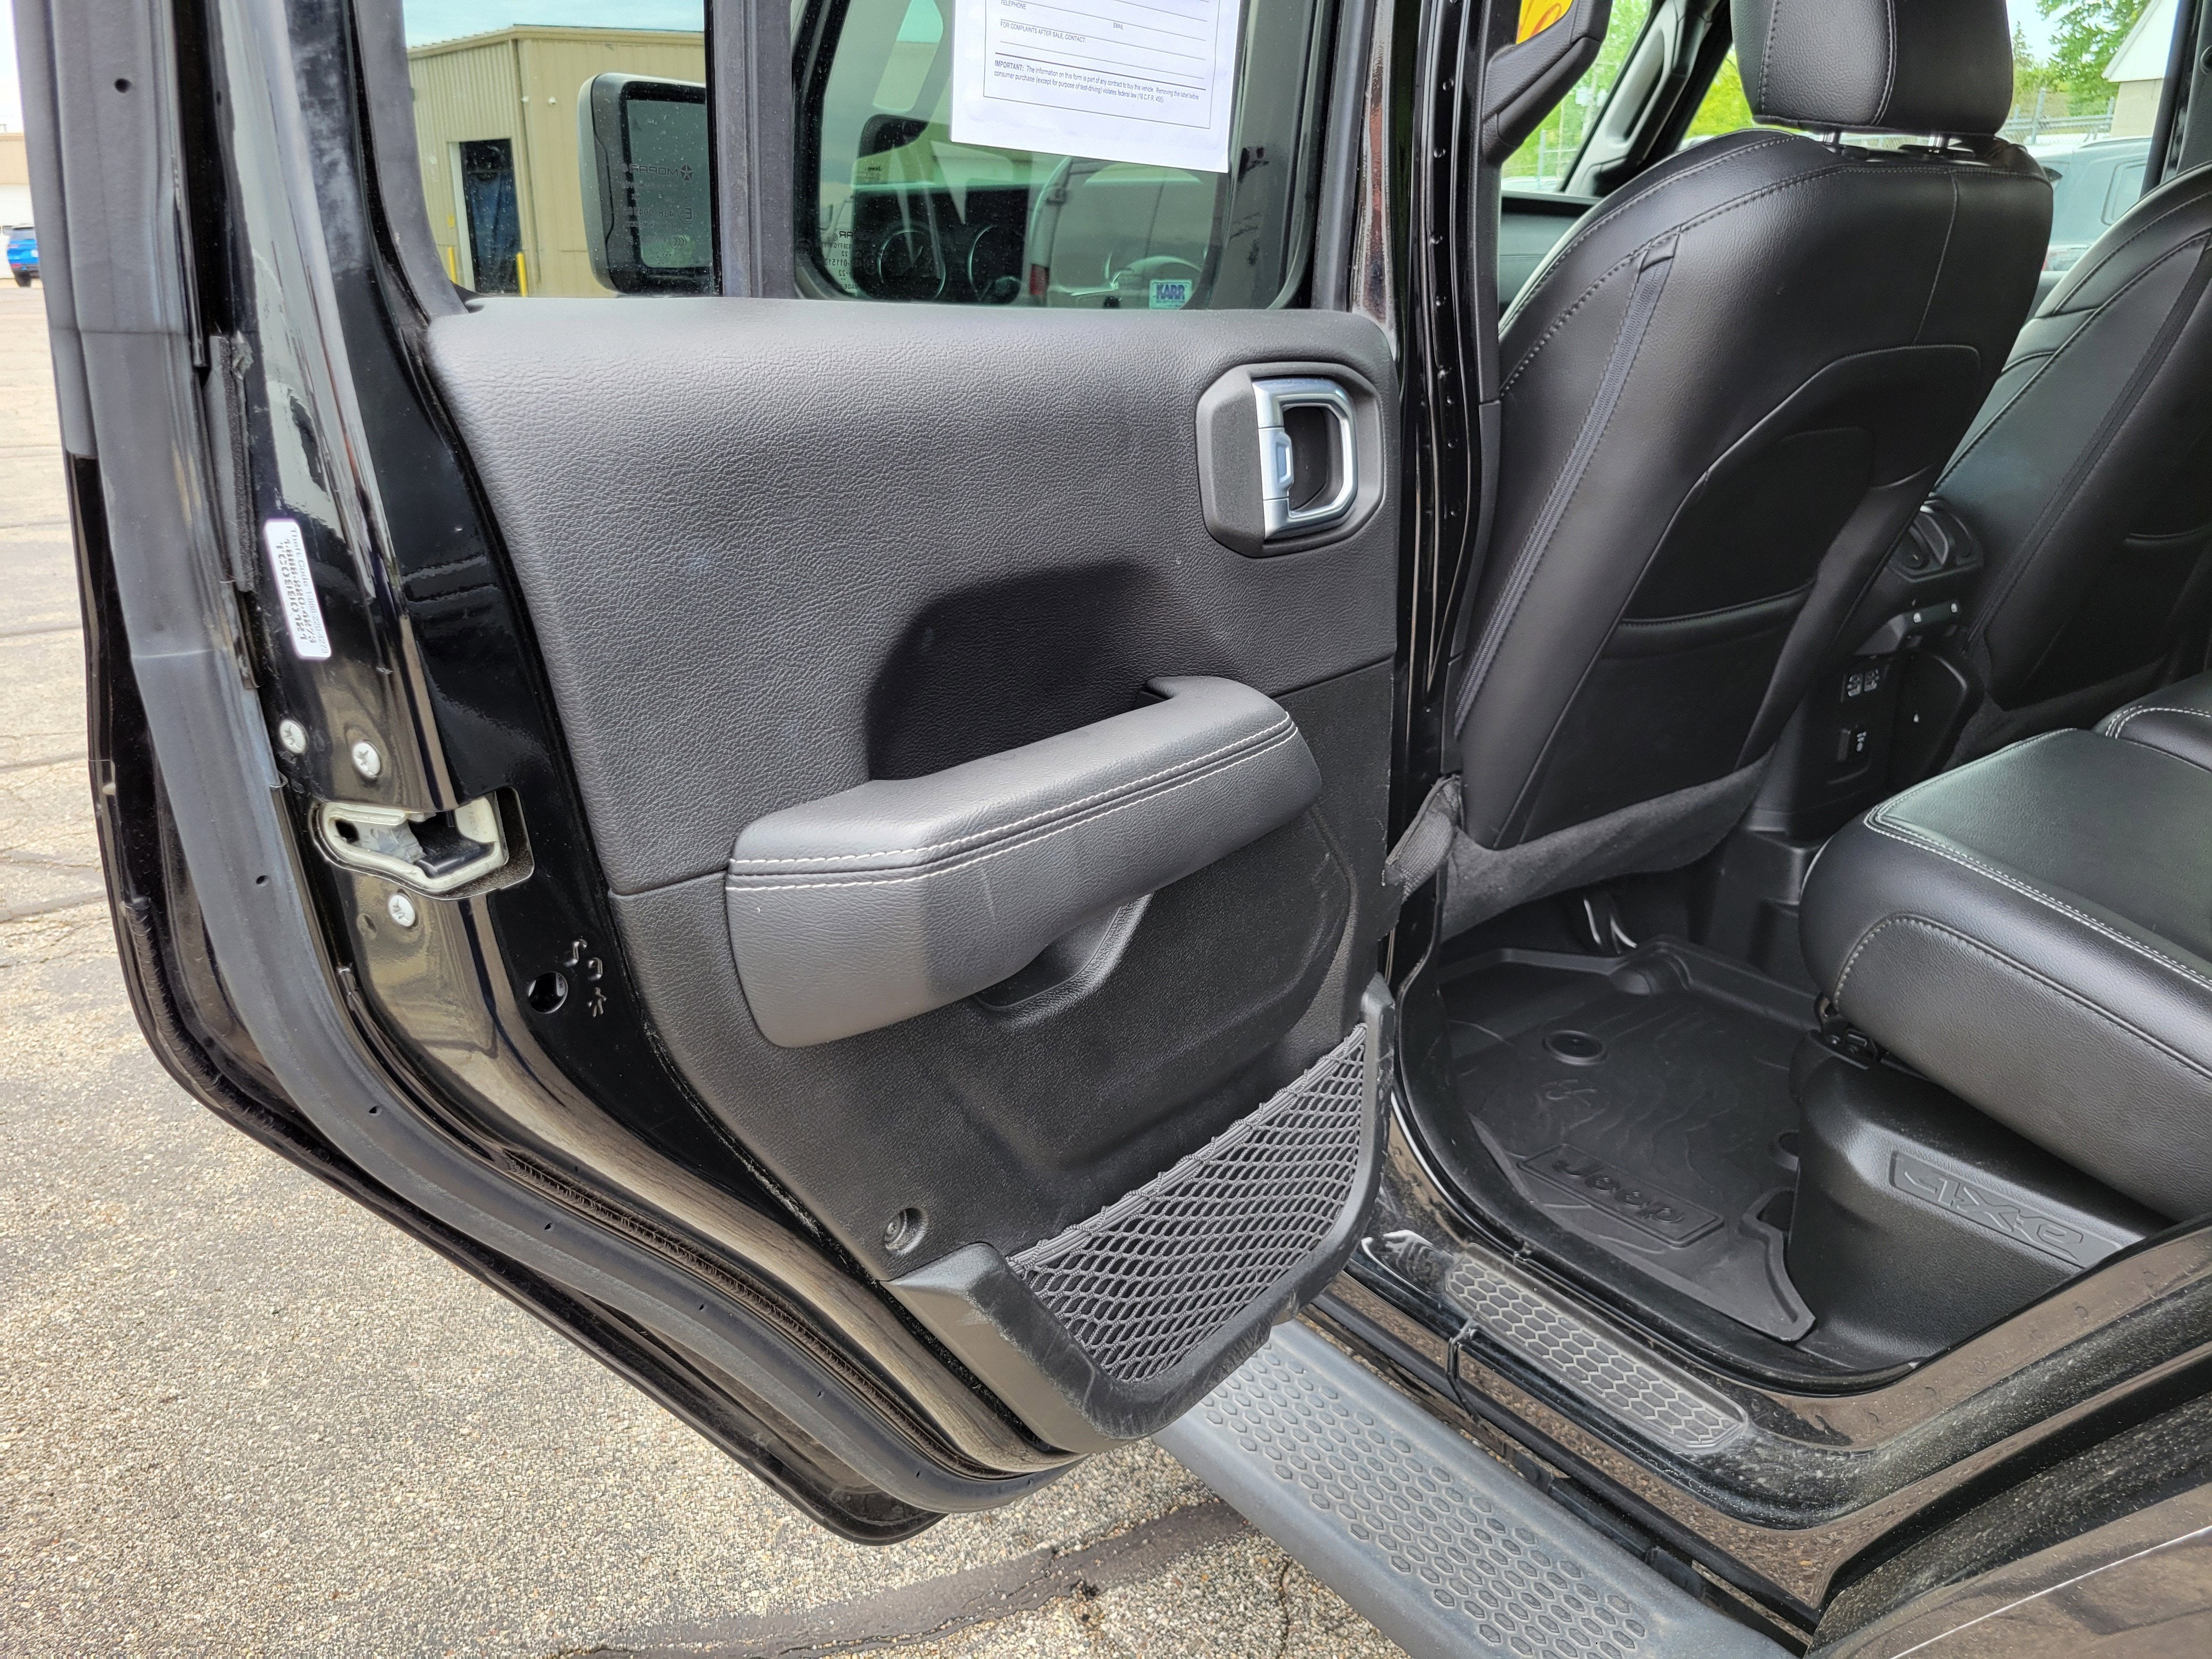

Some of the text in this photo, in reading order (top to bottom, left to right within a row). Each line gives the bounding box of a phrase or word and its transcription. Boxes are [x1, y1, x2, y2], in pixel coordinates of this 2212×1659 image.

[1001, 0, 1026, 10] TELEPHONE
[1011, 23, 1037, 34] COMPLAINTS
[1038, 29, 1052, 37] AFTER
[994, 70, 1015, 79] consumer
[1015, 75, 1035, 83] purchase
[1036, 76, 1052, 86] (except
[1058, 81, 1075, 89] purpose
[1080, 84, 1102, 94] test-driving)
[995, 60, 1024, 71] IMPORTANT:
[1026, 65, 1035, 74] The
[1036, 67, 1058, 77] information
[1156, 87, 1173, 98] Removing
[298, 560, 309, 587] Code
[1551, 1159, 1684, 1223] Jeep
